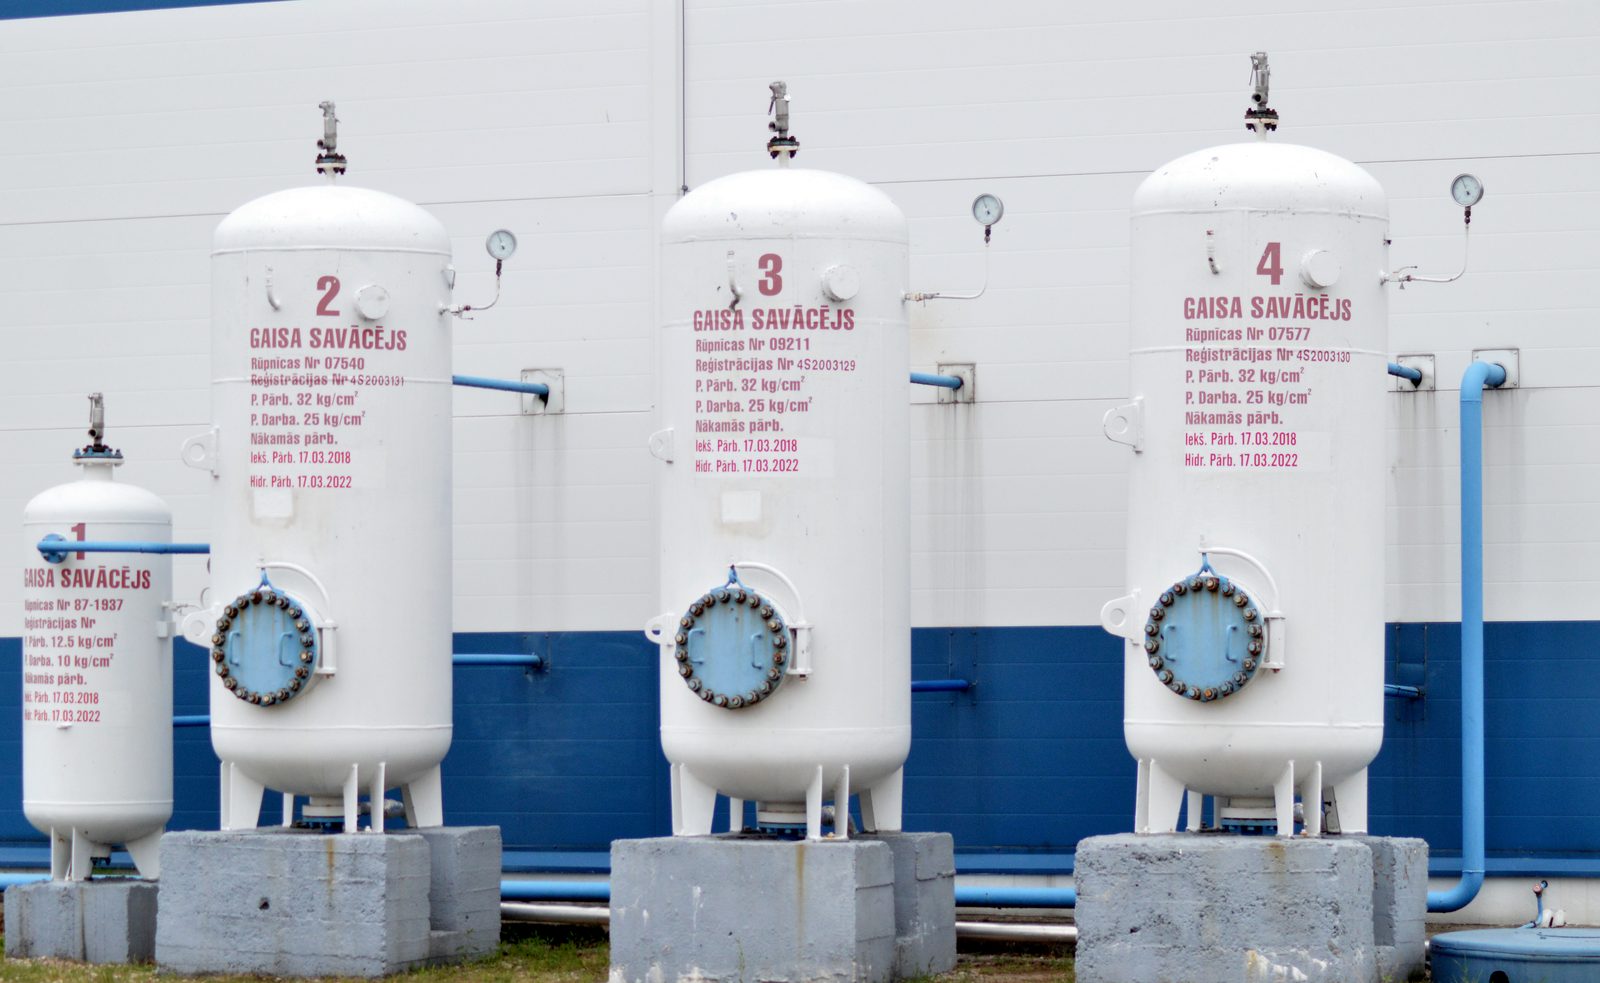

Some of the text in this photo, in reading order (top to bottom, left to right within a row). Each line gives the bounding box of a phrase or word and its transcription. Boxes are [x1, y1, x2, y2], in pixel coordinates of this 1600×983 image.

[1256, 242, 1284, 285] 4
[758, 253, 782, 296] 3
[316, 275, 340, 316] 2
[1184, 292, 1351, 321] GAISA SAVĀCĒJS
[693, 303, 854, 332] GAISA SAVĀCĒJS
[250, 324, 407, 351] GAISA SAVĀCĒJS
[1186, 327, 1310, 343] Rūpnīcas Nr 07577
[696, 338, 809, 354] Rūpnīcas Nr 09211
[1186, 347, 1350, 363] Reģistrācijas Nr 4S2003130
[251, 357, 364, 373] Rūpnīcas Nr 07540
[696, 358, 856, 373] Reģistrācijas Nr 4S2003129
[250, 372, 328, 388] Reģistrācijas
[332, 373, 349, 385] Nr
[1186, 370, 1194, 383] P.
[1199, 369, 1233, 383] Pārb.
[1239, 369, 1255, 382] 32
[696, 380, 703, 392] P.
[706, 379, 736, 392] Pārb.
[742, 378, 756, 391] 32
[251, 394, 258, 406] P.
[262, 393, 292, 406] Pārb.
[297, 393, 312, 405] 32
[1186, 391, 1194, 405] P.
[1199, 391, 1241, 404] Darba.
[1247, 390, 1263, 404] 25
[696, 400, 703, 413] P.
[707, 400, 744, 413] Darba.
[749, 399, 764, 412] 25
[251, 414, 258, 426] P.
[262, 413, 299, 426] Darba.
[304, 413, 319, 425] 25
[1186, 411, 1283, 426] Nākamās pārb.
[696, 419, 783, 434] Nākamās pārb.
[251, 432, 337, 446] Nākamās pārb.
[718, 439, 740, 452] Pārb.
[744, 439, 797, 452] 17.03.2018
[1211, 432, 1237, 445] Pārb.
[1241, 432, 1296, 446] 17.03.2018
[273, 451, 295, 463] Pārb.
[299, 451, 351, 464] 17.03.2018
[1185, 453, 1298, 467] Hidr. Pārb. 17.03.2022
[696, 459, 799, 472] Hidr. Pārb. 17.03.2022
[250, 475, 352, 488] Hidr. Pārb. 17.03.2022
[71, 523, 86, 560] 1
[25, 564, 151, 590] GAISA SAVĀCĒJS
[57, 599, 70, 611] Nr
[74, 598, 123, 611] 87-1937
[81, 617, 96, 628] Nr
[52, 636, 74, 647] 12.5
[58, 655, 70, 667] 10
[58, 673, 87, 686] pārb.
[53, 692, 99, 704] 17.03.2018
[52, 710, 100, 722] 17.03.2022
